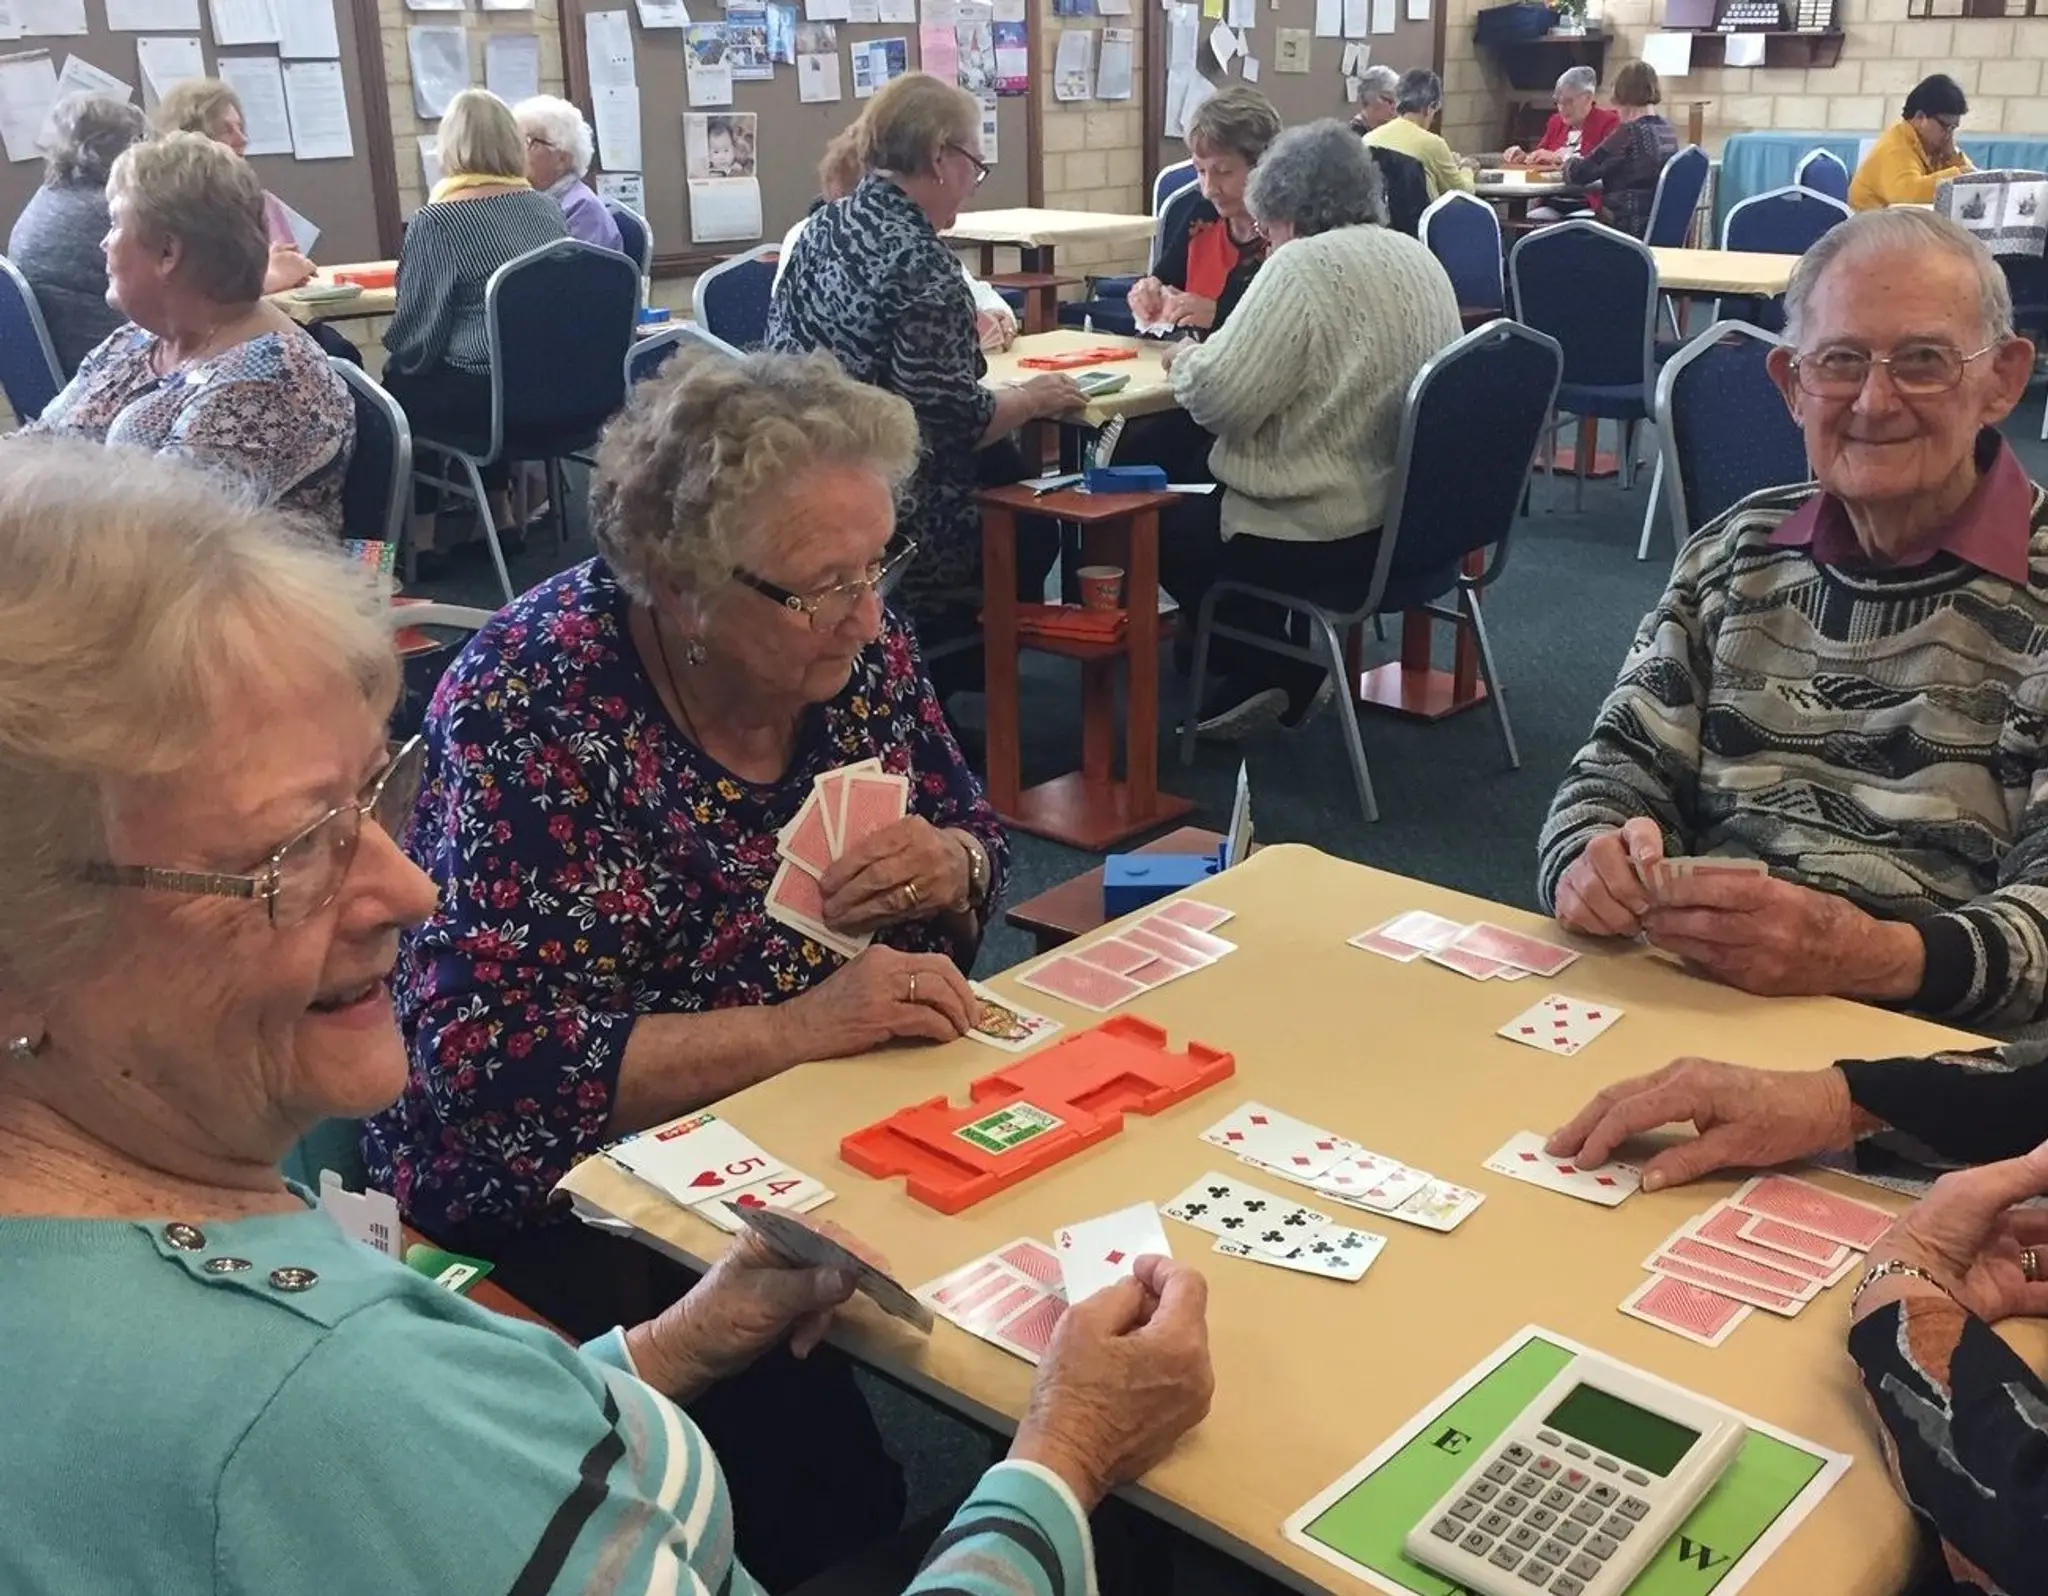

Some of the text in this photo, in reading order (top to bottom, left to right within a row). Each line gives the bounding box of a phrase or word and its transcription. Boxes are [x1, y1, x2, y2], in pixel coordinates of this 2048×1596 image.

[725, 1157, 766, 1175] 5
[766, 1180, 802, 1196] 4
[1167, 1208, 1183, 1217] 6
[1060, 1230, 1072, 1243] A
[1430, 1425, 1472, 1455] E
[1476, 1484, 1490, 1493] 4
[1521, 1478, 1535, 1489] 2
[1505, 1496, 1519, 1508] 5
[1551, 1490, 1564, 1502] 3
[1460, 1500, 1474, 1511] 7
[1622, 1498, 1644, 1512] NT
[1488, 1515, 1502, 1526] 8
[1534, 1508, 1548, 1521] 6
[1469, 1534, 1484, 1546] 0
[1516, 1528, 1530, 1541] 9
[1675, 1532, 1731, 1571] W
